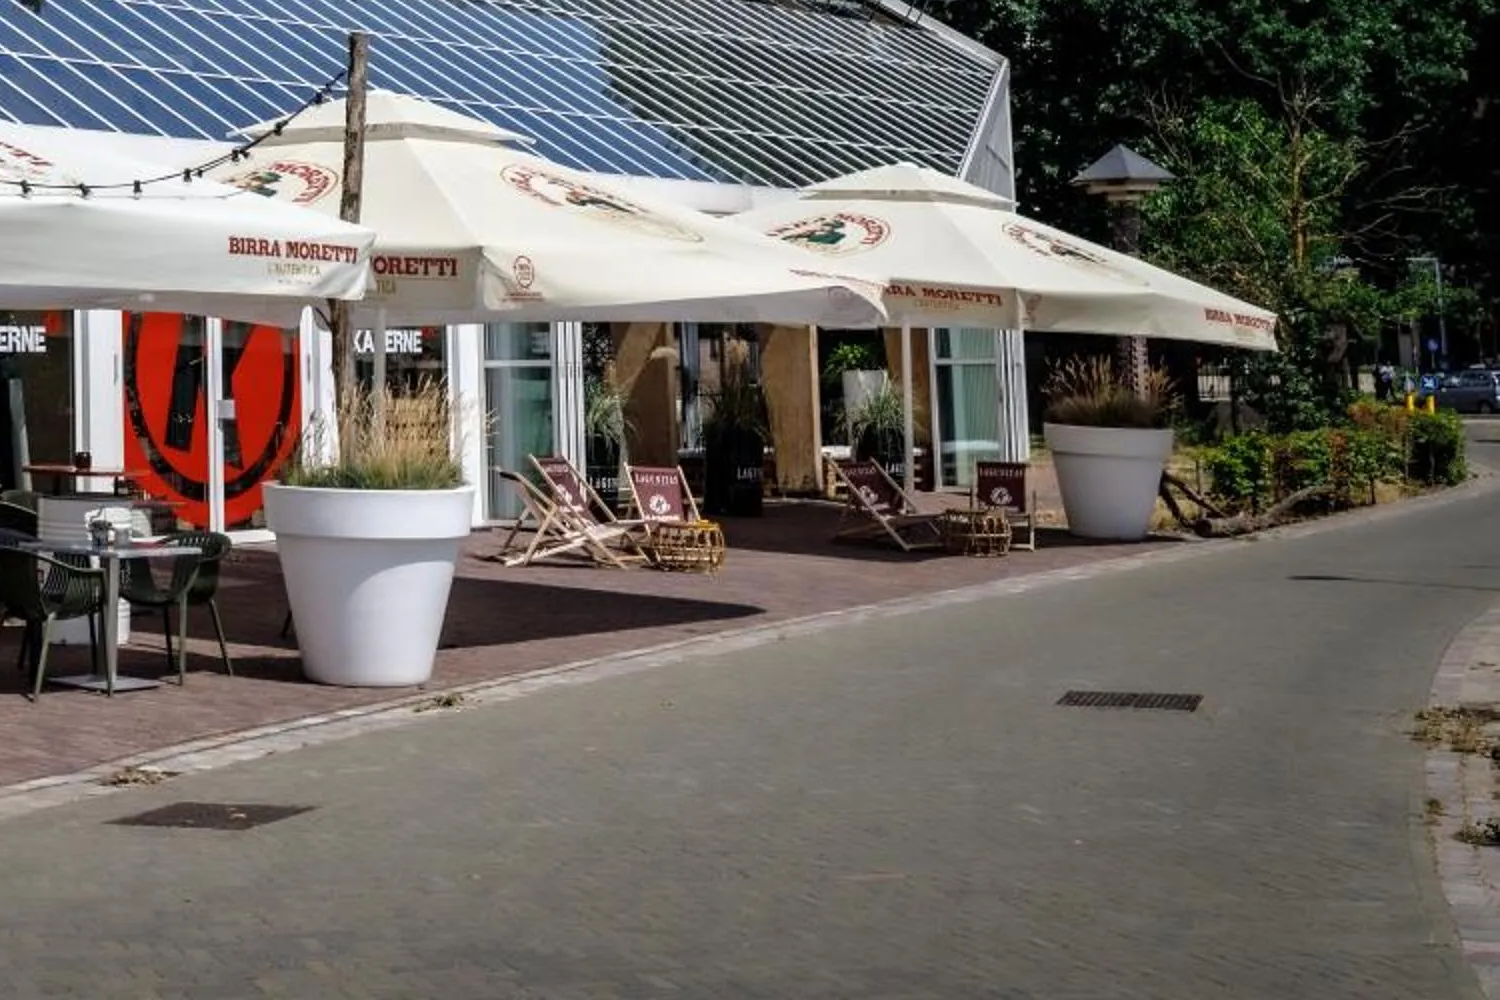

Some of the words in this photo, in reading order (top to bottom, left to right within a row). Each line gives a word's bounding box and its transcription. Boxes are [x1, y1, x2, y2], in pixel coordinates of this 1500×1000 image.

[228, 236, 282, 258] BIRRA
[285, 240, 359, 265] MORETTI
[369, 255, 457, 277] ORETTI
[352, 329, 423, 354] KAERNE
